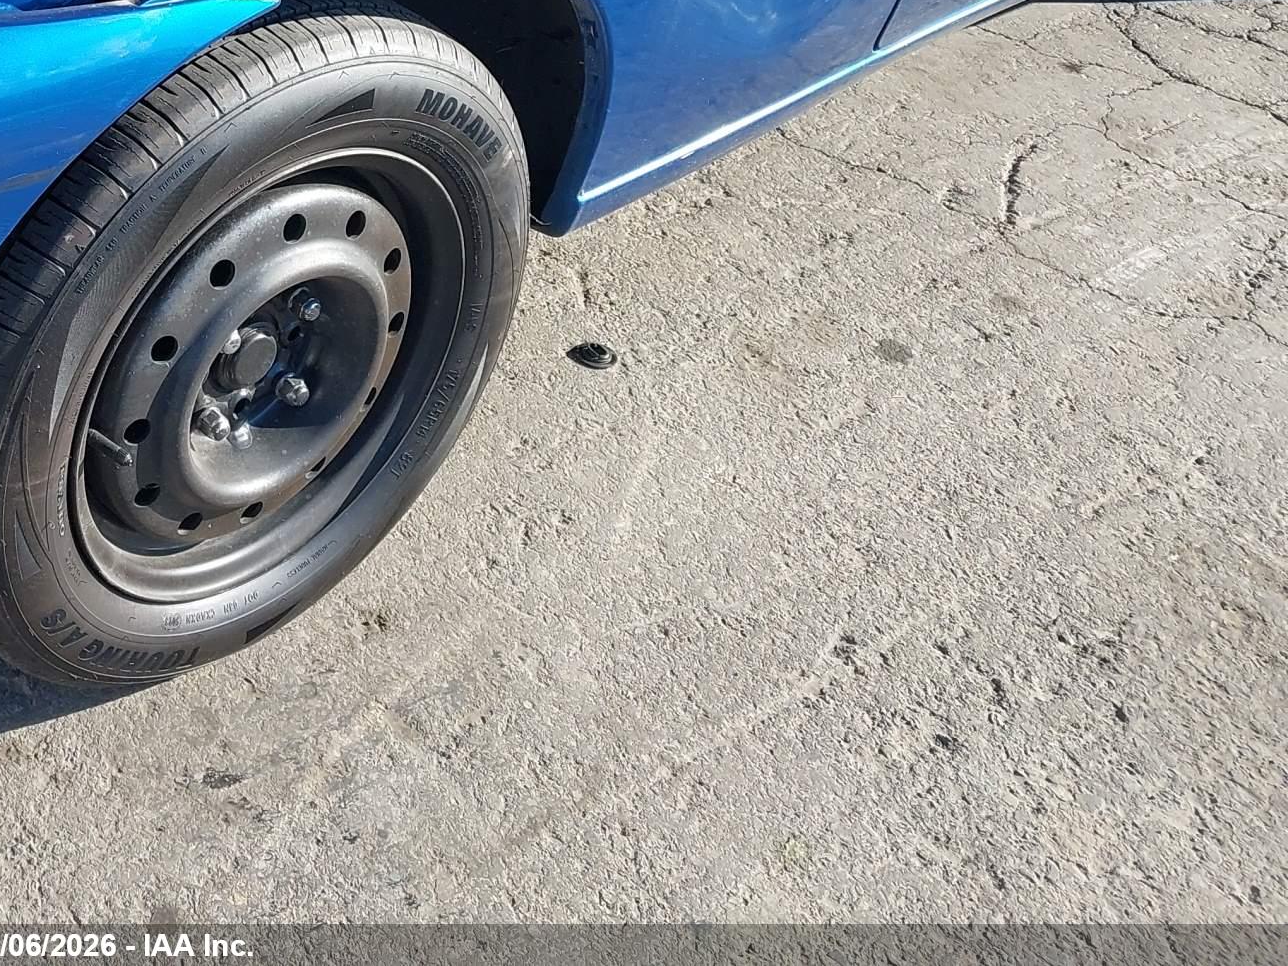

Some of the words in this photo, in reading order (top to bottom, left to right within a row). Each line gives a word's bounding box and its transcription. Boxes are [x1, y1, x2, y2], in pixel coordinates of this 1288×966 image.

[415, 88, 502, 163] MOHAVE
[41, 608, 86, 649] A/S
[77, 638, 200, 674] TOURING
